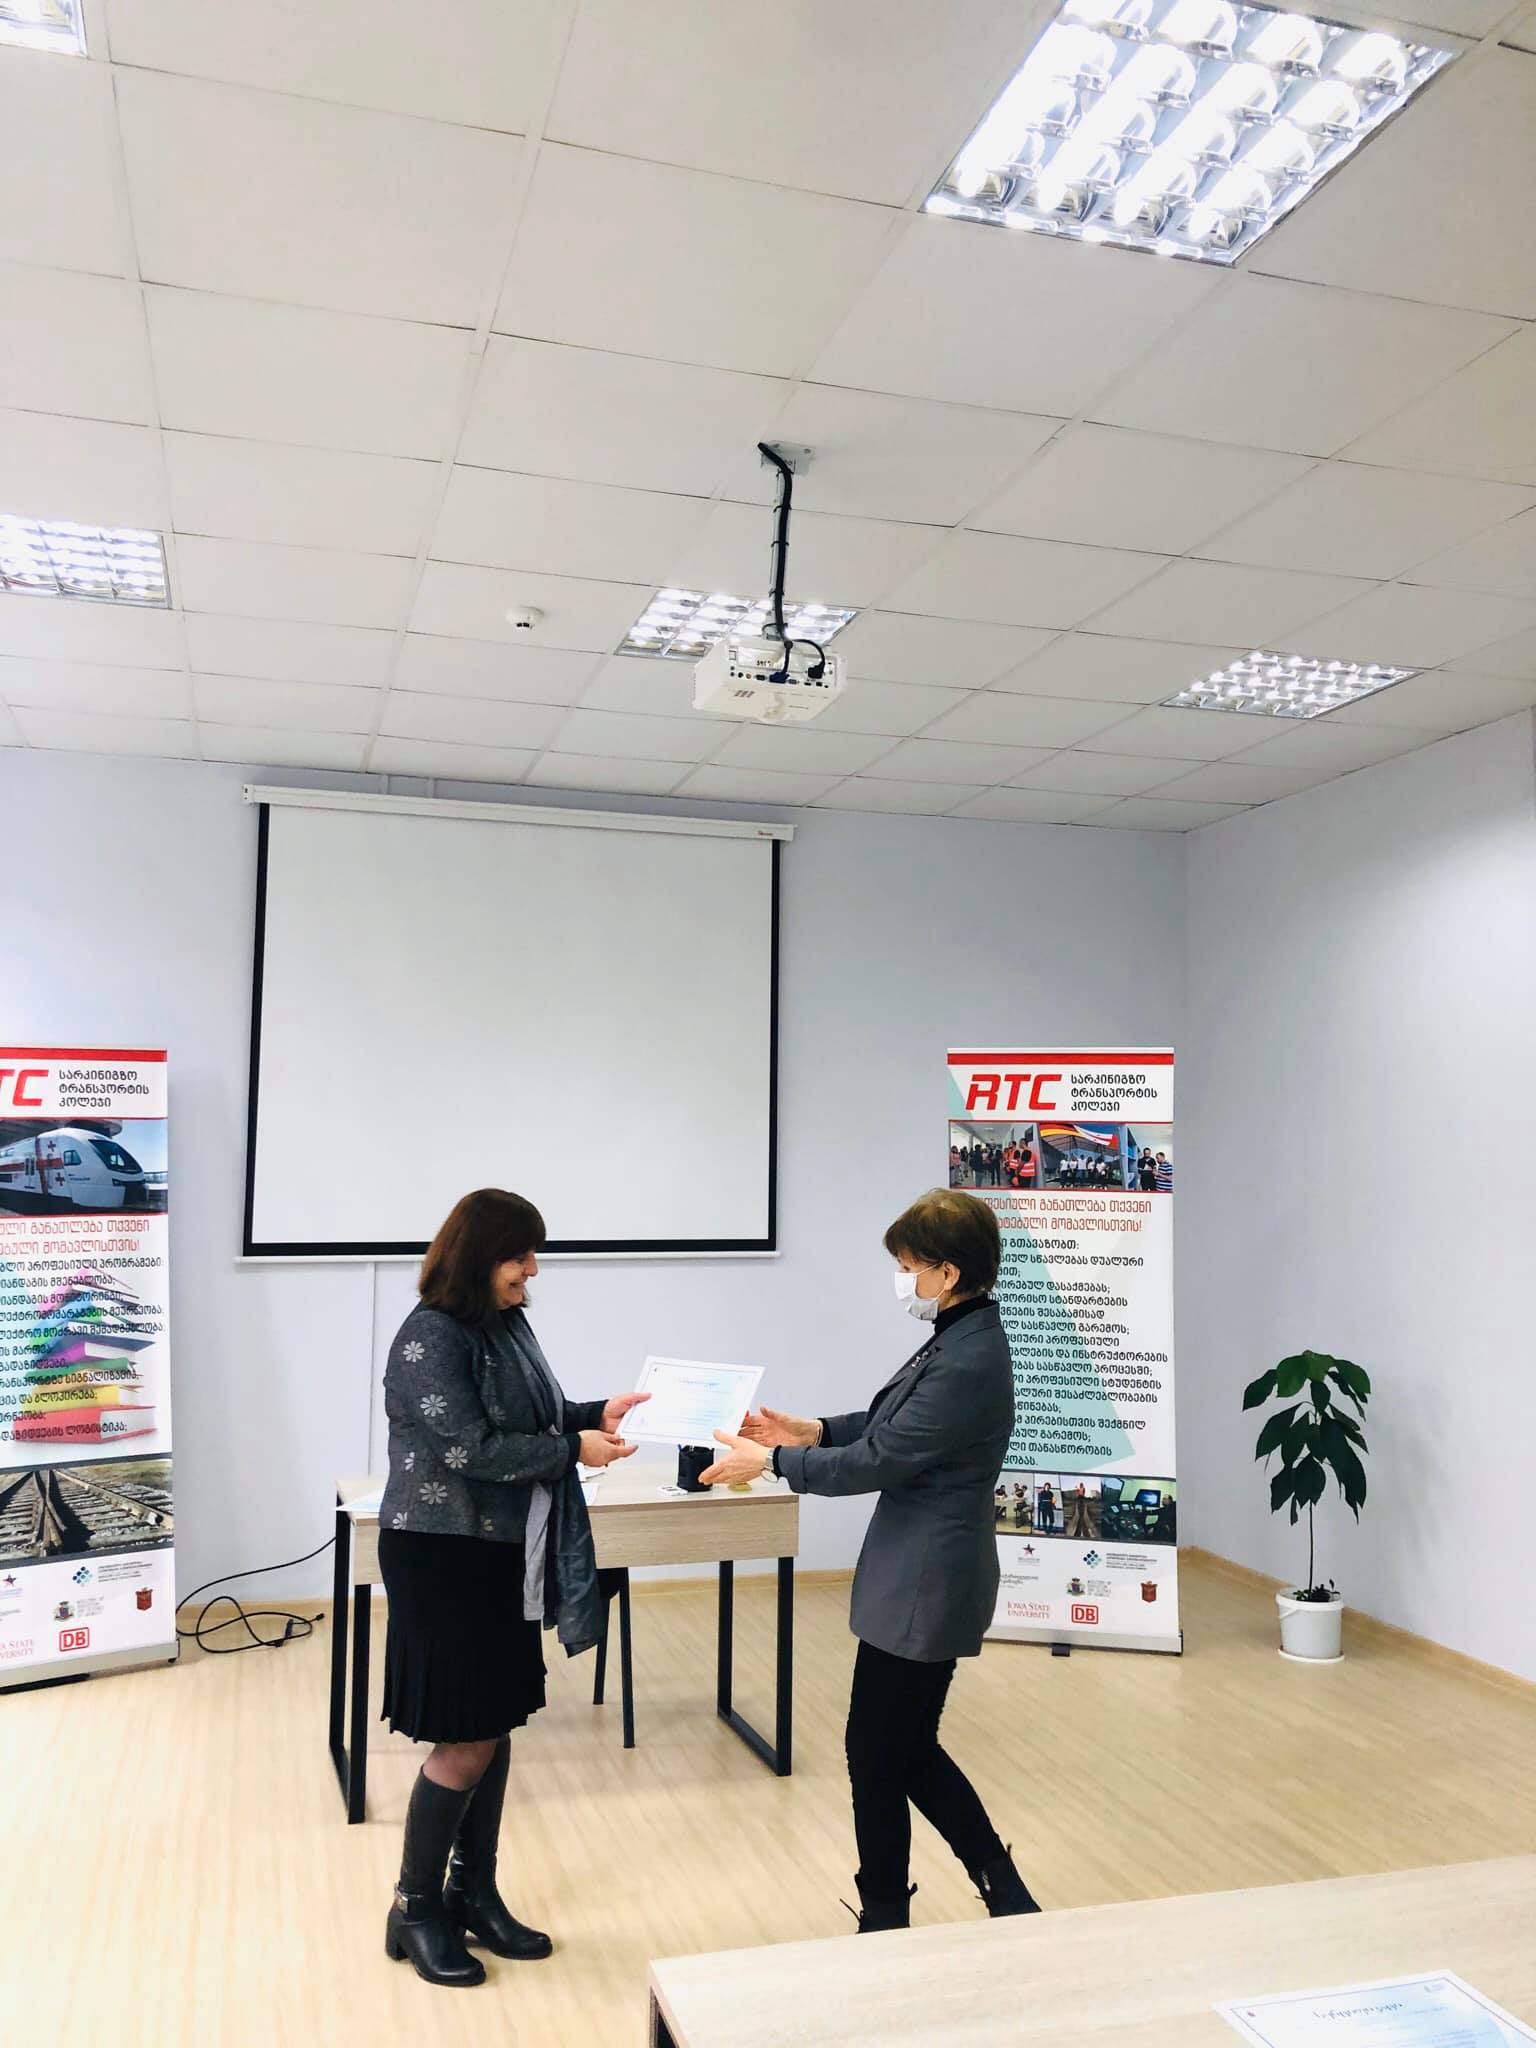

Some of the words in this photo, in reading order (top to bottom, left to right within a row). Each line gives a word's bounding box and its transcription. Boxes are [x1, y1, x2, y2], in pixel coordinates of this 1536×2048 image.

[59, 1069, 137, 1080] სარკინიგზო
[1070, 1074, 1146, 1085] სარკინიგზო
[59, 1083, 149, 1094] ტრანსპორტის
[965, 1074, 1062, 1110] RTC
[1070, 1087, 1158, 1098] ტრანსპორტის
[59, 1097, 111, 1107] კოლეჯი
[1070, 1101, 1120, 1111] კოლეჯი
[1039, 1199, 1106, 1212] განათლება
[1109, 1200, 1152, 1213] თქვენი
[31, 1220, 103, 1234] განათლება
[1051, 1217, 1142, 1232] მომავლისთვის!
[1009, 1238, 1079, 1250] გთავაზობთ:
[27, 1258, 97, 1271] პროფესიული
[1030, 1254, 1088, 1265] სწავლებას
[1090, 1256, 1144, 1267] დუალური
[1046, 1281, 1110, 1294] დასაქმებას;
[1049, 1295, 1128, 1307] სტანდარტების
[1037, 1307, 1105, 1319] შესაბამისად
[1021, 1320, 1076, 1332] სასწავლო
[1078, 1323, 1130, 1335] გარემოს;
[1046, 1334, 1119, 1347] პროფესიული
[1056, 1348, 1070, 1359] და
[1072, 1349, 1168, 1363] ინსტრუქტორების
[1036, 1361, 1092, 1373] სასწავლო
[1094, 1364, 1153, 1377] პროცესში;
[1026, 1374, 1100, 1387] პროფესიული
[1101, 1378, 1162, 1390] სტუდენტის
[19, 1393, 33, 1404] და
[1054, 1389, 1158, 1403] შესაძლებლობების
[1024, 1415, 1096, 1428] პირებისთვის
[1097, 1418, 1146, 1430] შექმნილ
[1040, 1429, 1091, 1442] გარემოს;
[1028, 1442, 1112, 1456] თანასწორობის
[1029, 1602, 1050, 1611] STATE
[1007, 1610, 1050, 1619] UNIVERSITY
[1075, 1607, 1096, 1622] DB
[63, 1632, 86, 1648] DB
